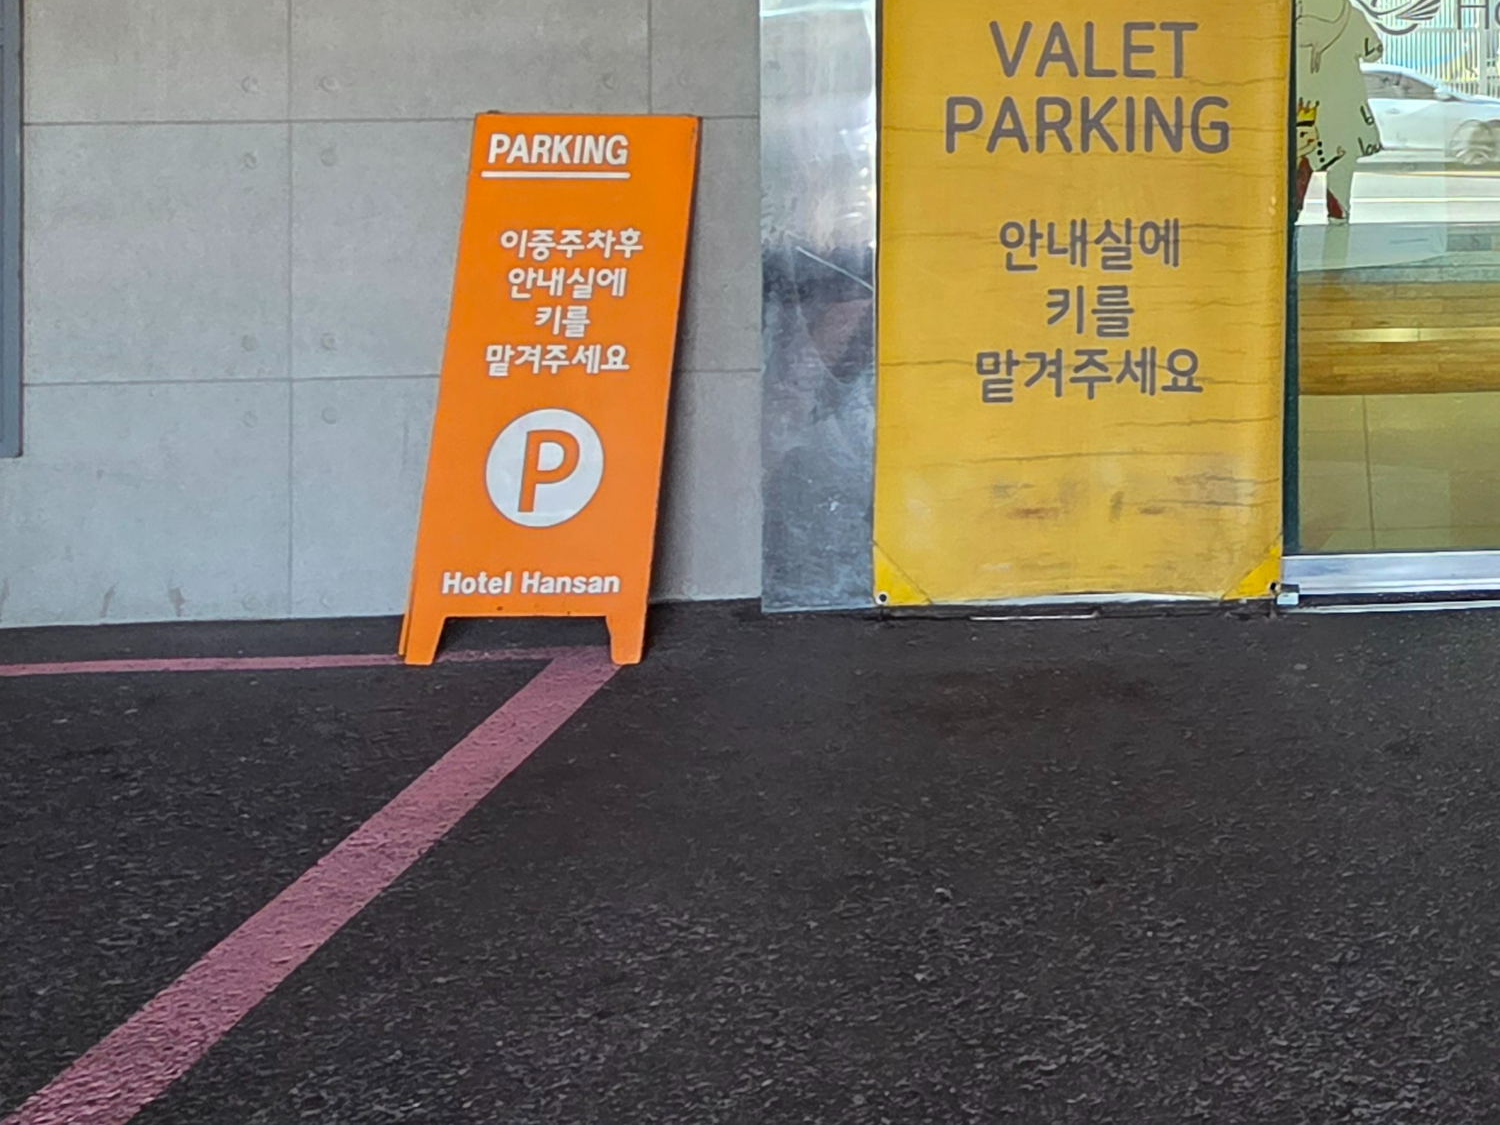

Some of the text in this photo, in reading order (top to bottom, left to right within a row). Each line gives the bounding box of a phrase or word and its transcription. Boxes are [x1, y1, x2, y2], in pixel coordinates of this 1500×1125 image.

[989, 20, 1198, 79] VALET
[944, 96, 1231, 156] PARKING
[487, 133, 629, 166] PARKING
[499, 227, 644, 261] 이중주차후
[998, 217, 1182, 273] 안내실에
[508, 267, 627, 300] 안내실에
[534, 305, 591, 339] 키를
[1045, 283, 1136, 339] 키를
[484, 343, 631, 377] 맡겨주세요
[975, 346, 1205, 404] 맡겨주세요
[517, 429, 581, 514] P
[441, 571, 621, 596] Hotel Hansan
